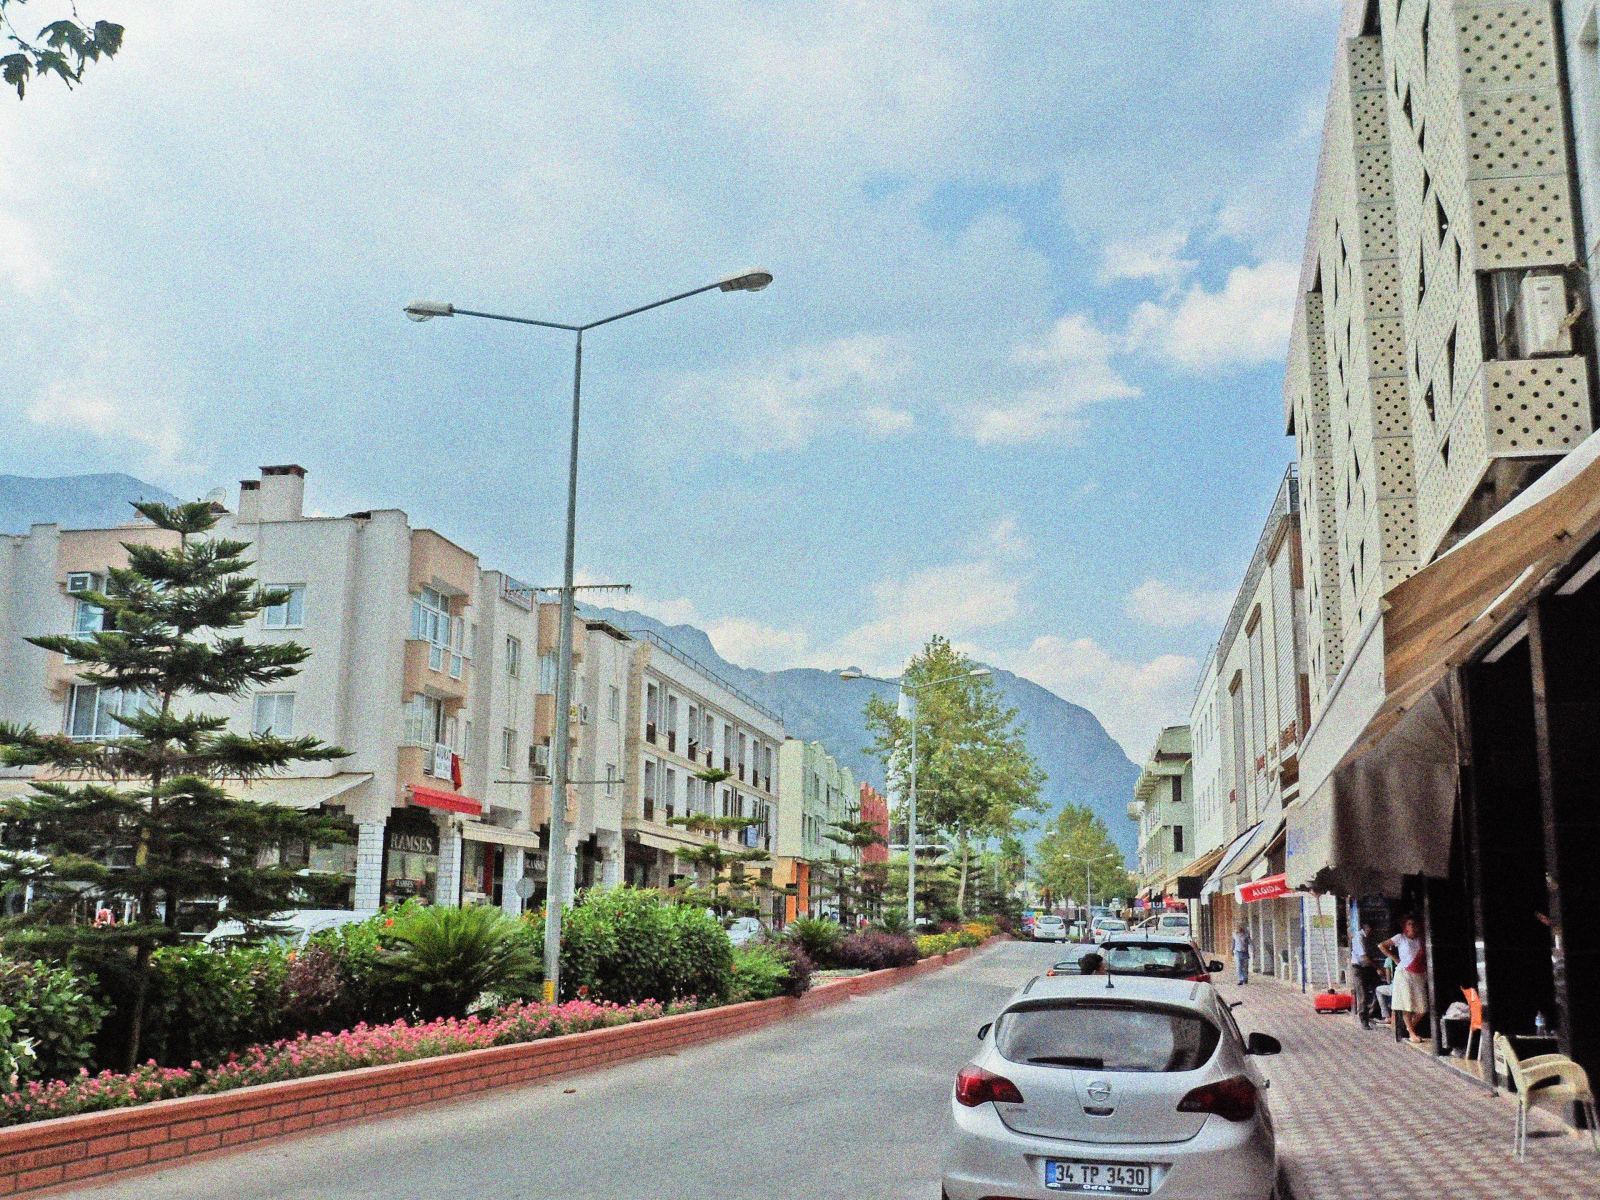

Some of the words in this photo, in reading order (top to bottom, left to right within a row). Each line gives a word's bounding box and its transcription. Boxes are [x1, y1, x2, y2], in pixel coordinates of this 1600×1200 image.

[391, 832, 432, 853] RAMSES
[1252, 885, 1281, 896] ALGIDA
[1056, 1164, 1074, 1182] 34
[1081, 1165, 1099, 1183] TP
[1106, 1167, 1145, 1186] 3430
